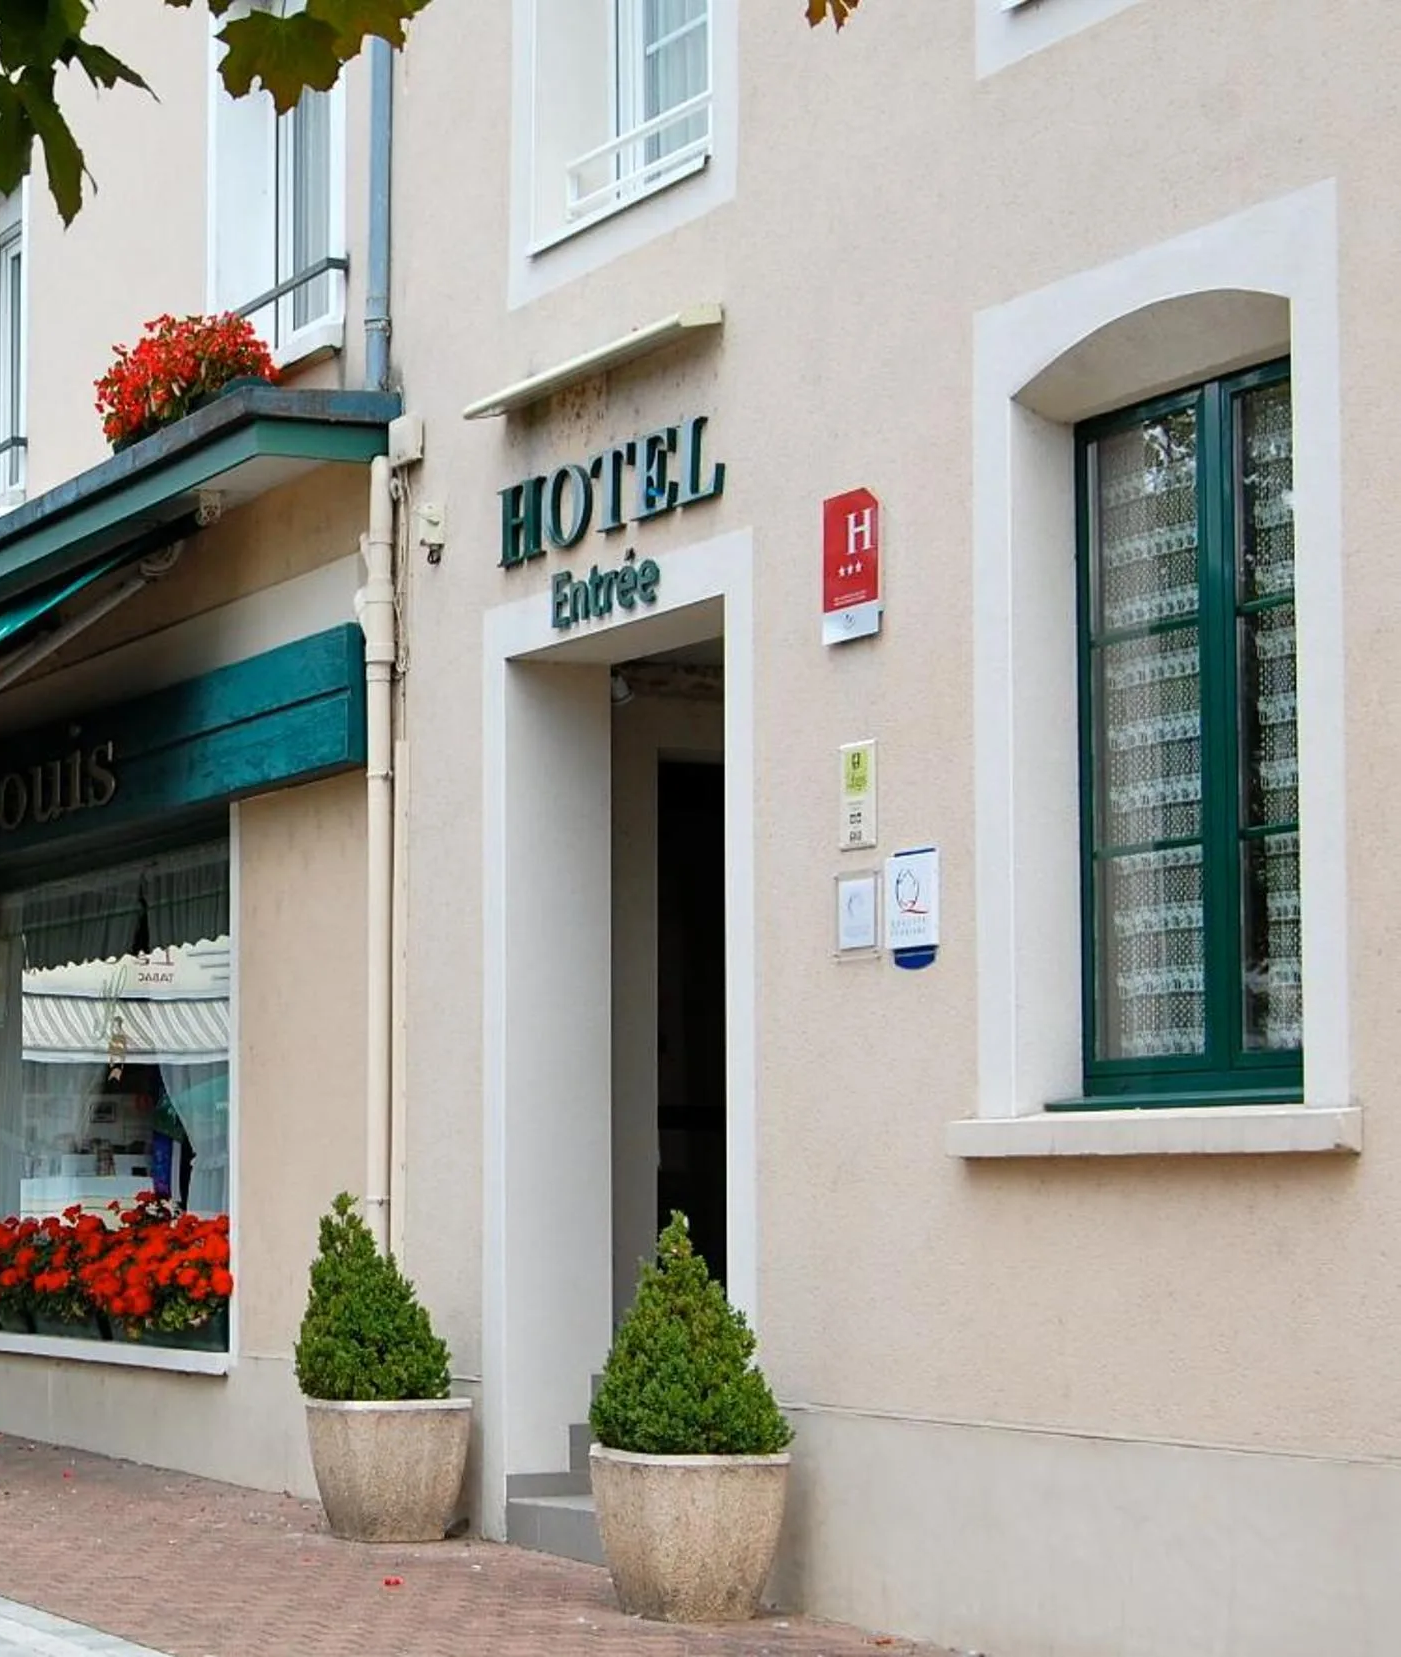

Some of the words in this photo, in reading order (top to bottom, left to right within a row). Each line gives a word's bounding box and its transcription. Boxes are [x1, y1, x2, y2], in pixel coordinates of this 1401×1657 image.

[497, 416, 725, 568] HOTEL
[844, 507, 874, 556] H
[550, 547, 661, 630] Entrée
